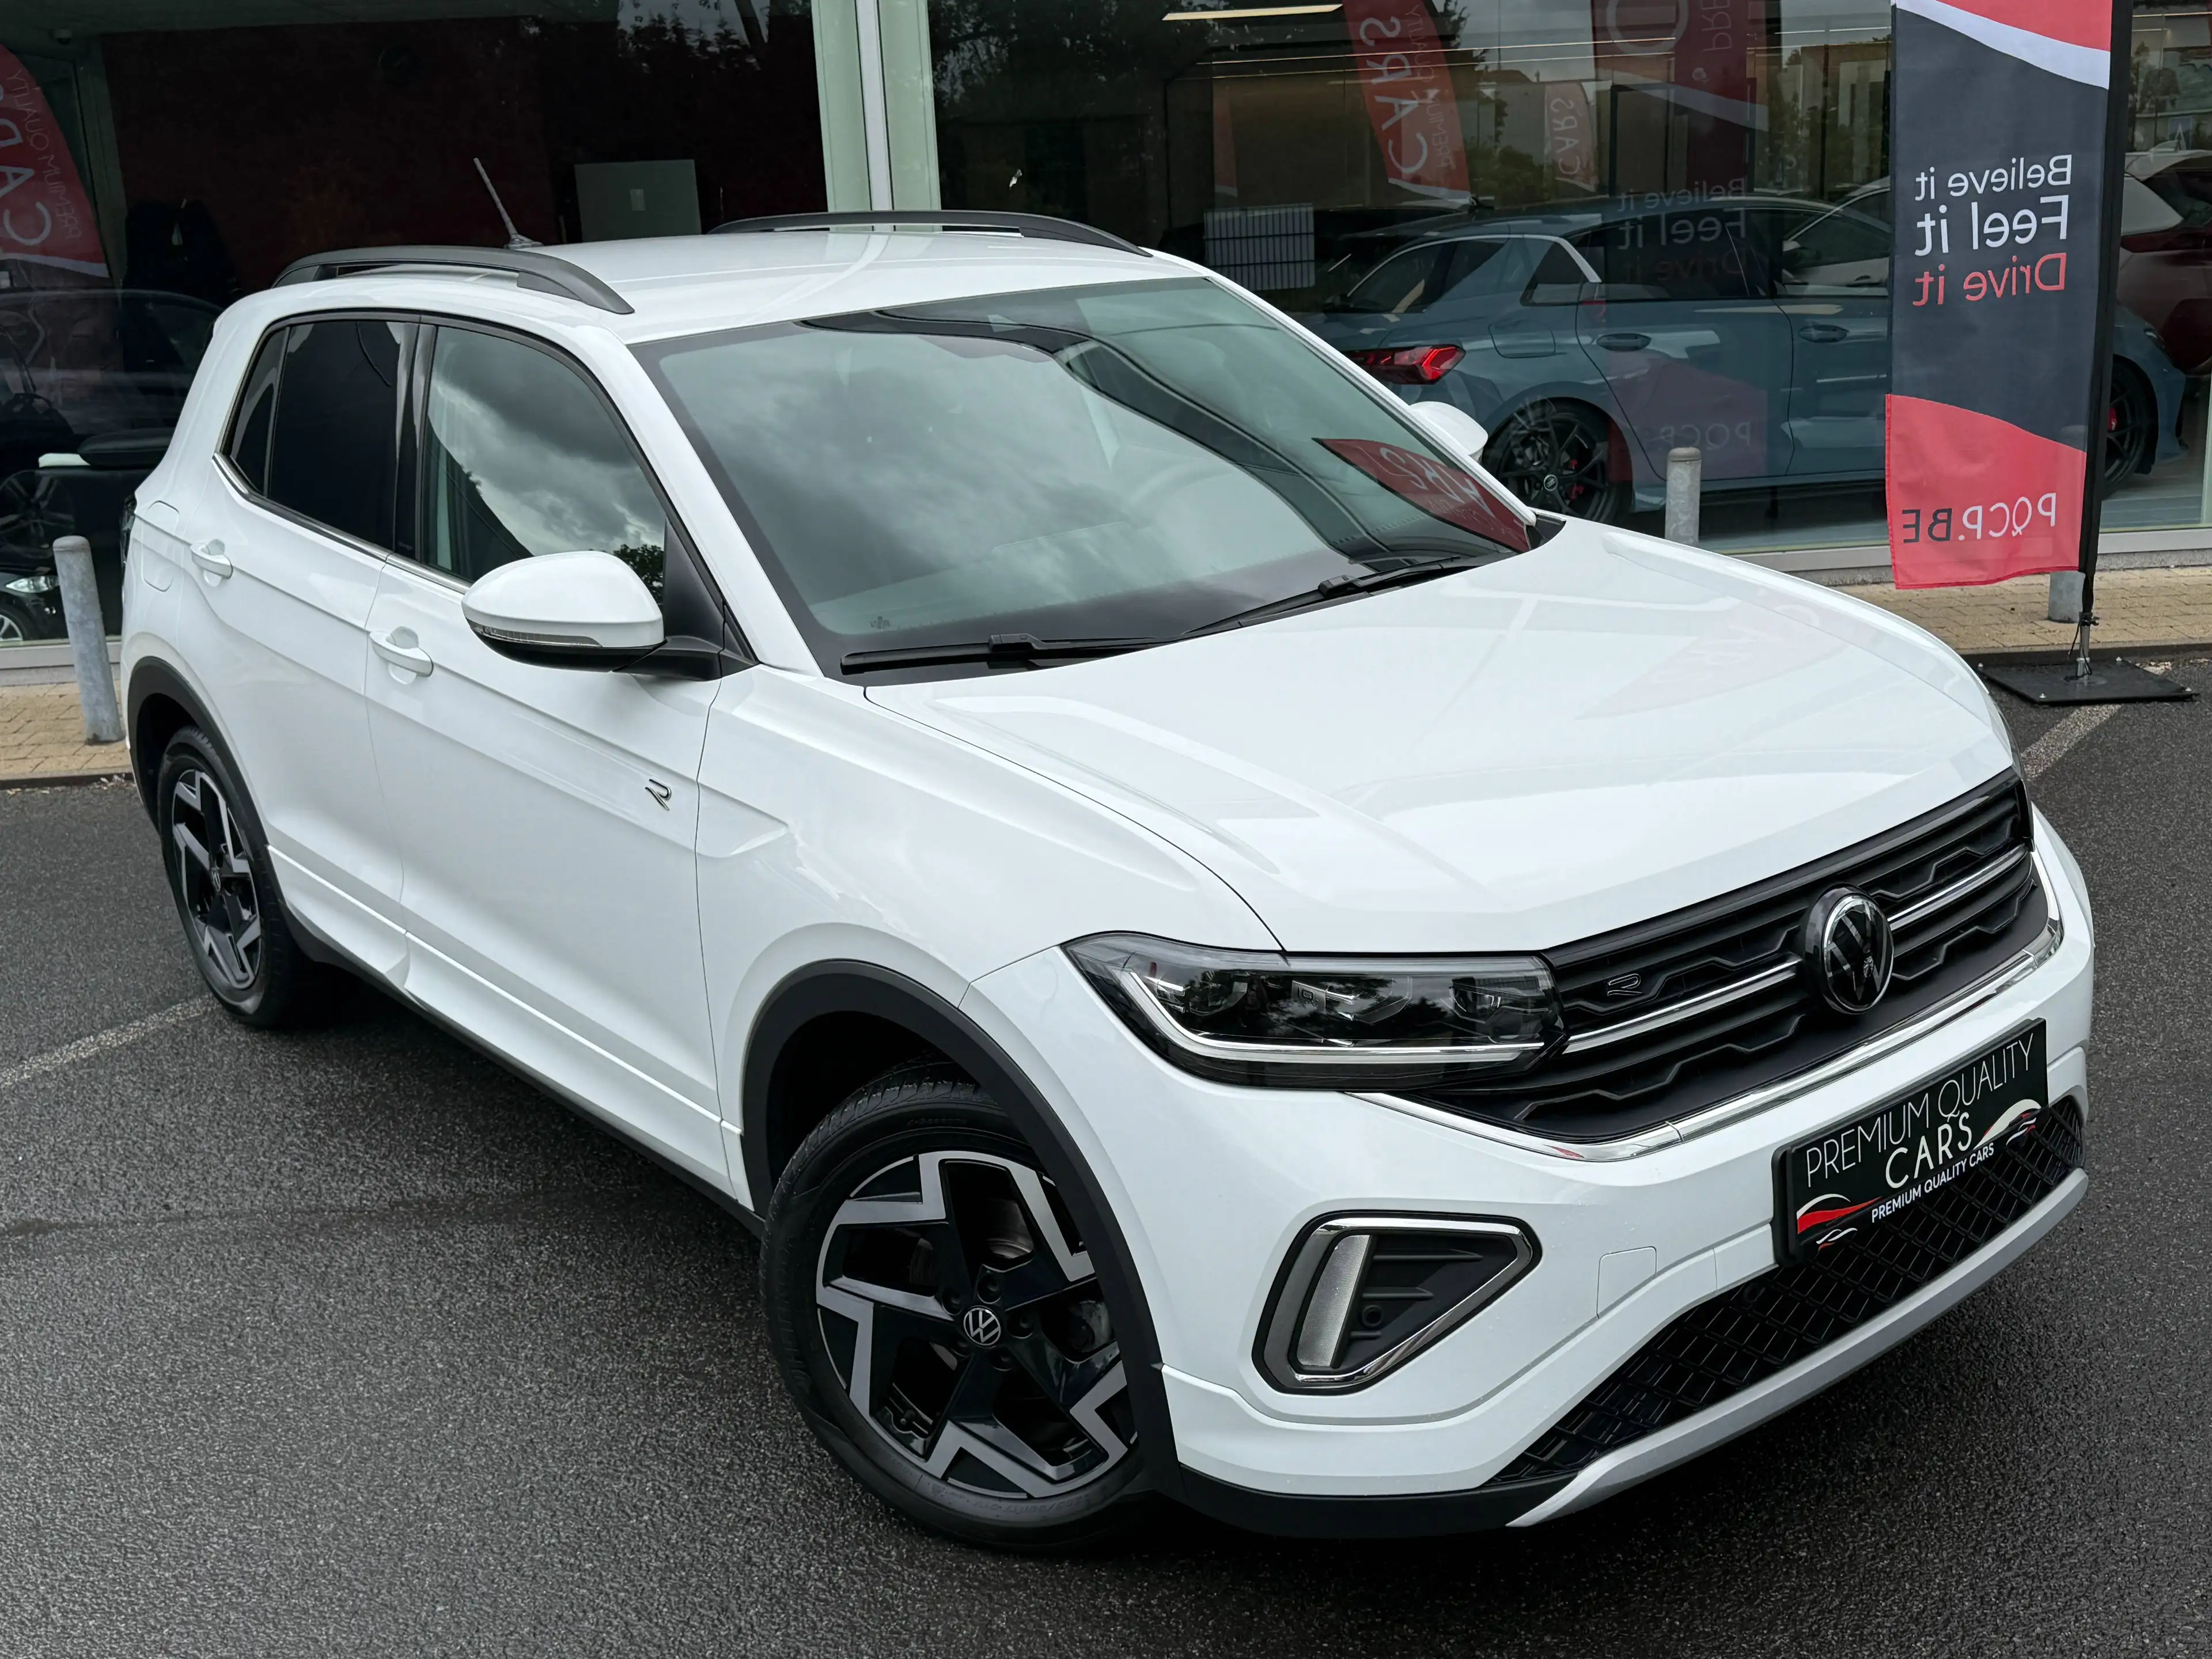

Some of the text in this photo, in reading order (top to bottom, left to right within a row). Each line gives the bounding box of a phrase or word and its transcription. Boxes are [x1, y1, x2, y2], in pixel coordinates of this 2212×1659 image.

[1806, 1033, 2034, 1188] PREMIUM QUALITY
[1885, 1112, 1972, 1188] CARS
[1872, 1142, 1995, 1224] PREMIUM QUALITY CARS
